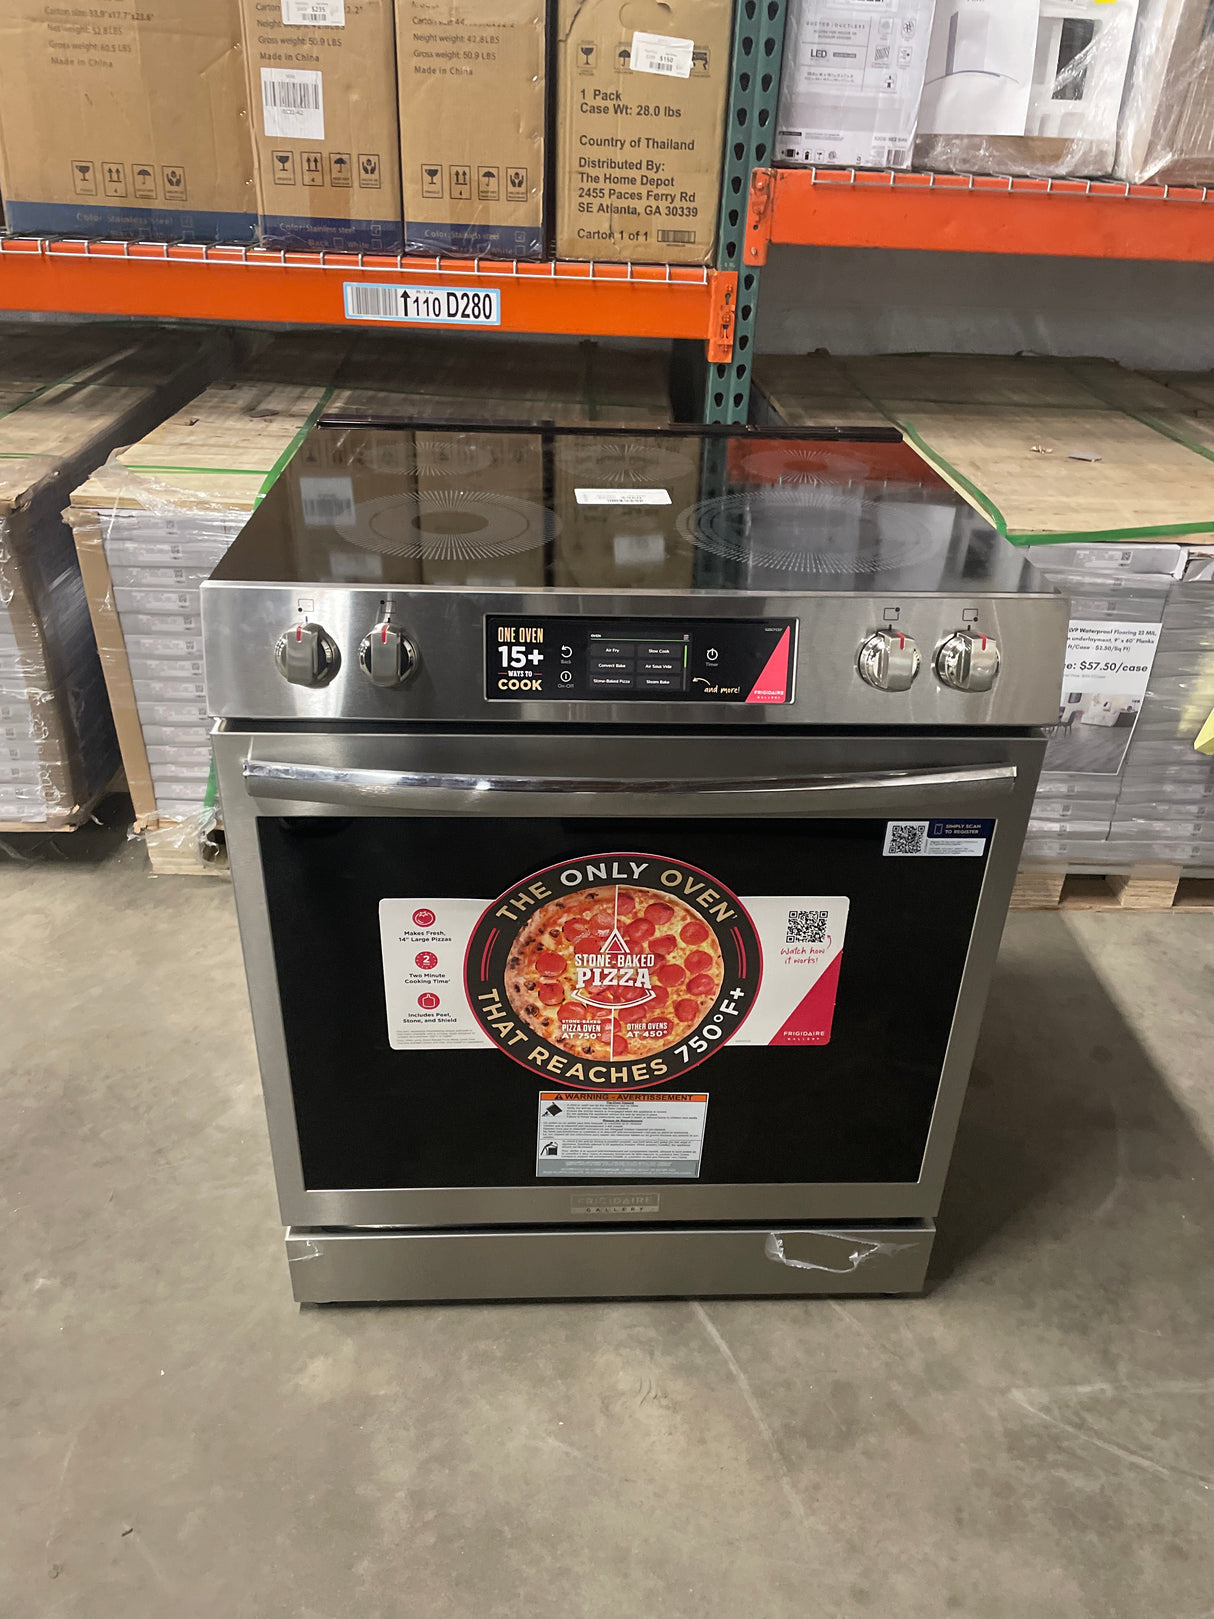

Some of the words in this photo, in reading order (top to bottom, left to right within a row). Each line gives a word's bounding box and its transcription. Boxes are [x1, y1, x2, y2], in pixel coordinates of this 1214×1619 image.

[258, 36, 279, 46] Gross
[308, 38, 326, 47] 50.9
[327, 38, 342, 48] LBS
[413, 33, 437, 44] Neight
[439, 36, 465, 45] weight:
[260, 52, 283, 61] Made
[285, 53, 294, 61] in
[295, 53, 320, 63] China
[413, 50, 434, 59] Gross
[463, 52, 480, 61] 50.9
[481, 52, 496, 61] LBS
[810, 49, 828, 59] LED
[51, 57, 75, 67] Made
[77, 58, 86, 67] in
[88, 58, 113, 68] China
[415, 66, 436, 75] Made
[439, 67, 448, 75] in
[450, 67, 473, 76] China
[580, 88, 587, 100] 1
[593, 89, 623, 101] Pack
[580, 102, 610, 115] Case
[613, 104, 633, 116] Wt:
[636, 104, 661, 117] 28.0
[664, 106, 682, 118] lbs
[579, 135, 626, 151] Country
[629, 137, 642, 149] of
[645, 138, 695, 151] Thailand
[578, 156, 643, 171] Distributed
[645, 160, 666, 174] By:
[579, 172, 601, 184] The
[603, 173, 637, 185] Home
[640, 175, 675, 189] Depot
[578, 187, 605, 199] 2455
[608, 189, 643, 201] Paces
[646, 190, 677, 205] Ferry
[679, 192, 696, 203] Rd
[578, 202, 594, 213] SE
[596, 203, 641, 217] Atlanta,
[644, 205, 662, 217] GA
[664, 206, 698, 218] 30339
[577, 228, 616, 241] Carton
[619, 230, 625, 241] 1
[628, 231, 641, 242] of
[643, 231, 649, 242] 1
[413, 296, 442, 317] 110
[446, 292, 493, 320] D280
[497, 627, 516, 643] ONE
[519, 627, 544, 643] OVEN
[1079, 628, 1113, 637] Waterproof
[498, 645, 544, 668] 15+
[1079, 660, 1148, 673] $57.50/case
[498, 679, 543, 691] COOK
[703, 685, 718, 693] and
[720, 686, 740, 694] more!
[496, 881, 552, 922] THE
[560, 862, 649, 886] ONLY
[780, 947, 807, 955] Watch
[809, 946, 825, 954] how
[422, 955, 430, 963] 2
[575, 954, 655, 967] STONE-BAKED
[785, 957, 791, 965] it
[576, 968, 652, 989] PIZZA
[561, 1024, 581, 1032] PIZZA
[582, 1024, 601, 1032] OVEN
[627, 1023, 647, 1031] OTHER
[647, 1022, 668, 1030] OVENS
[478, 989, 529, 1049] THAT
[527, 1046, 668, 1084] REACHES
[673, 987, 746, 1064] 750°F+
[564, 1093, 609, 1101] WARNING
[577, 1196, 651, 1206] FRIGIDAIRE
